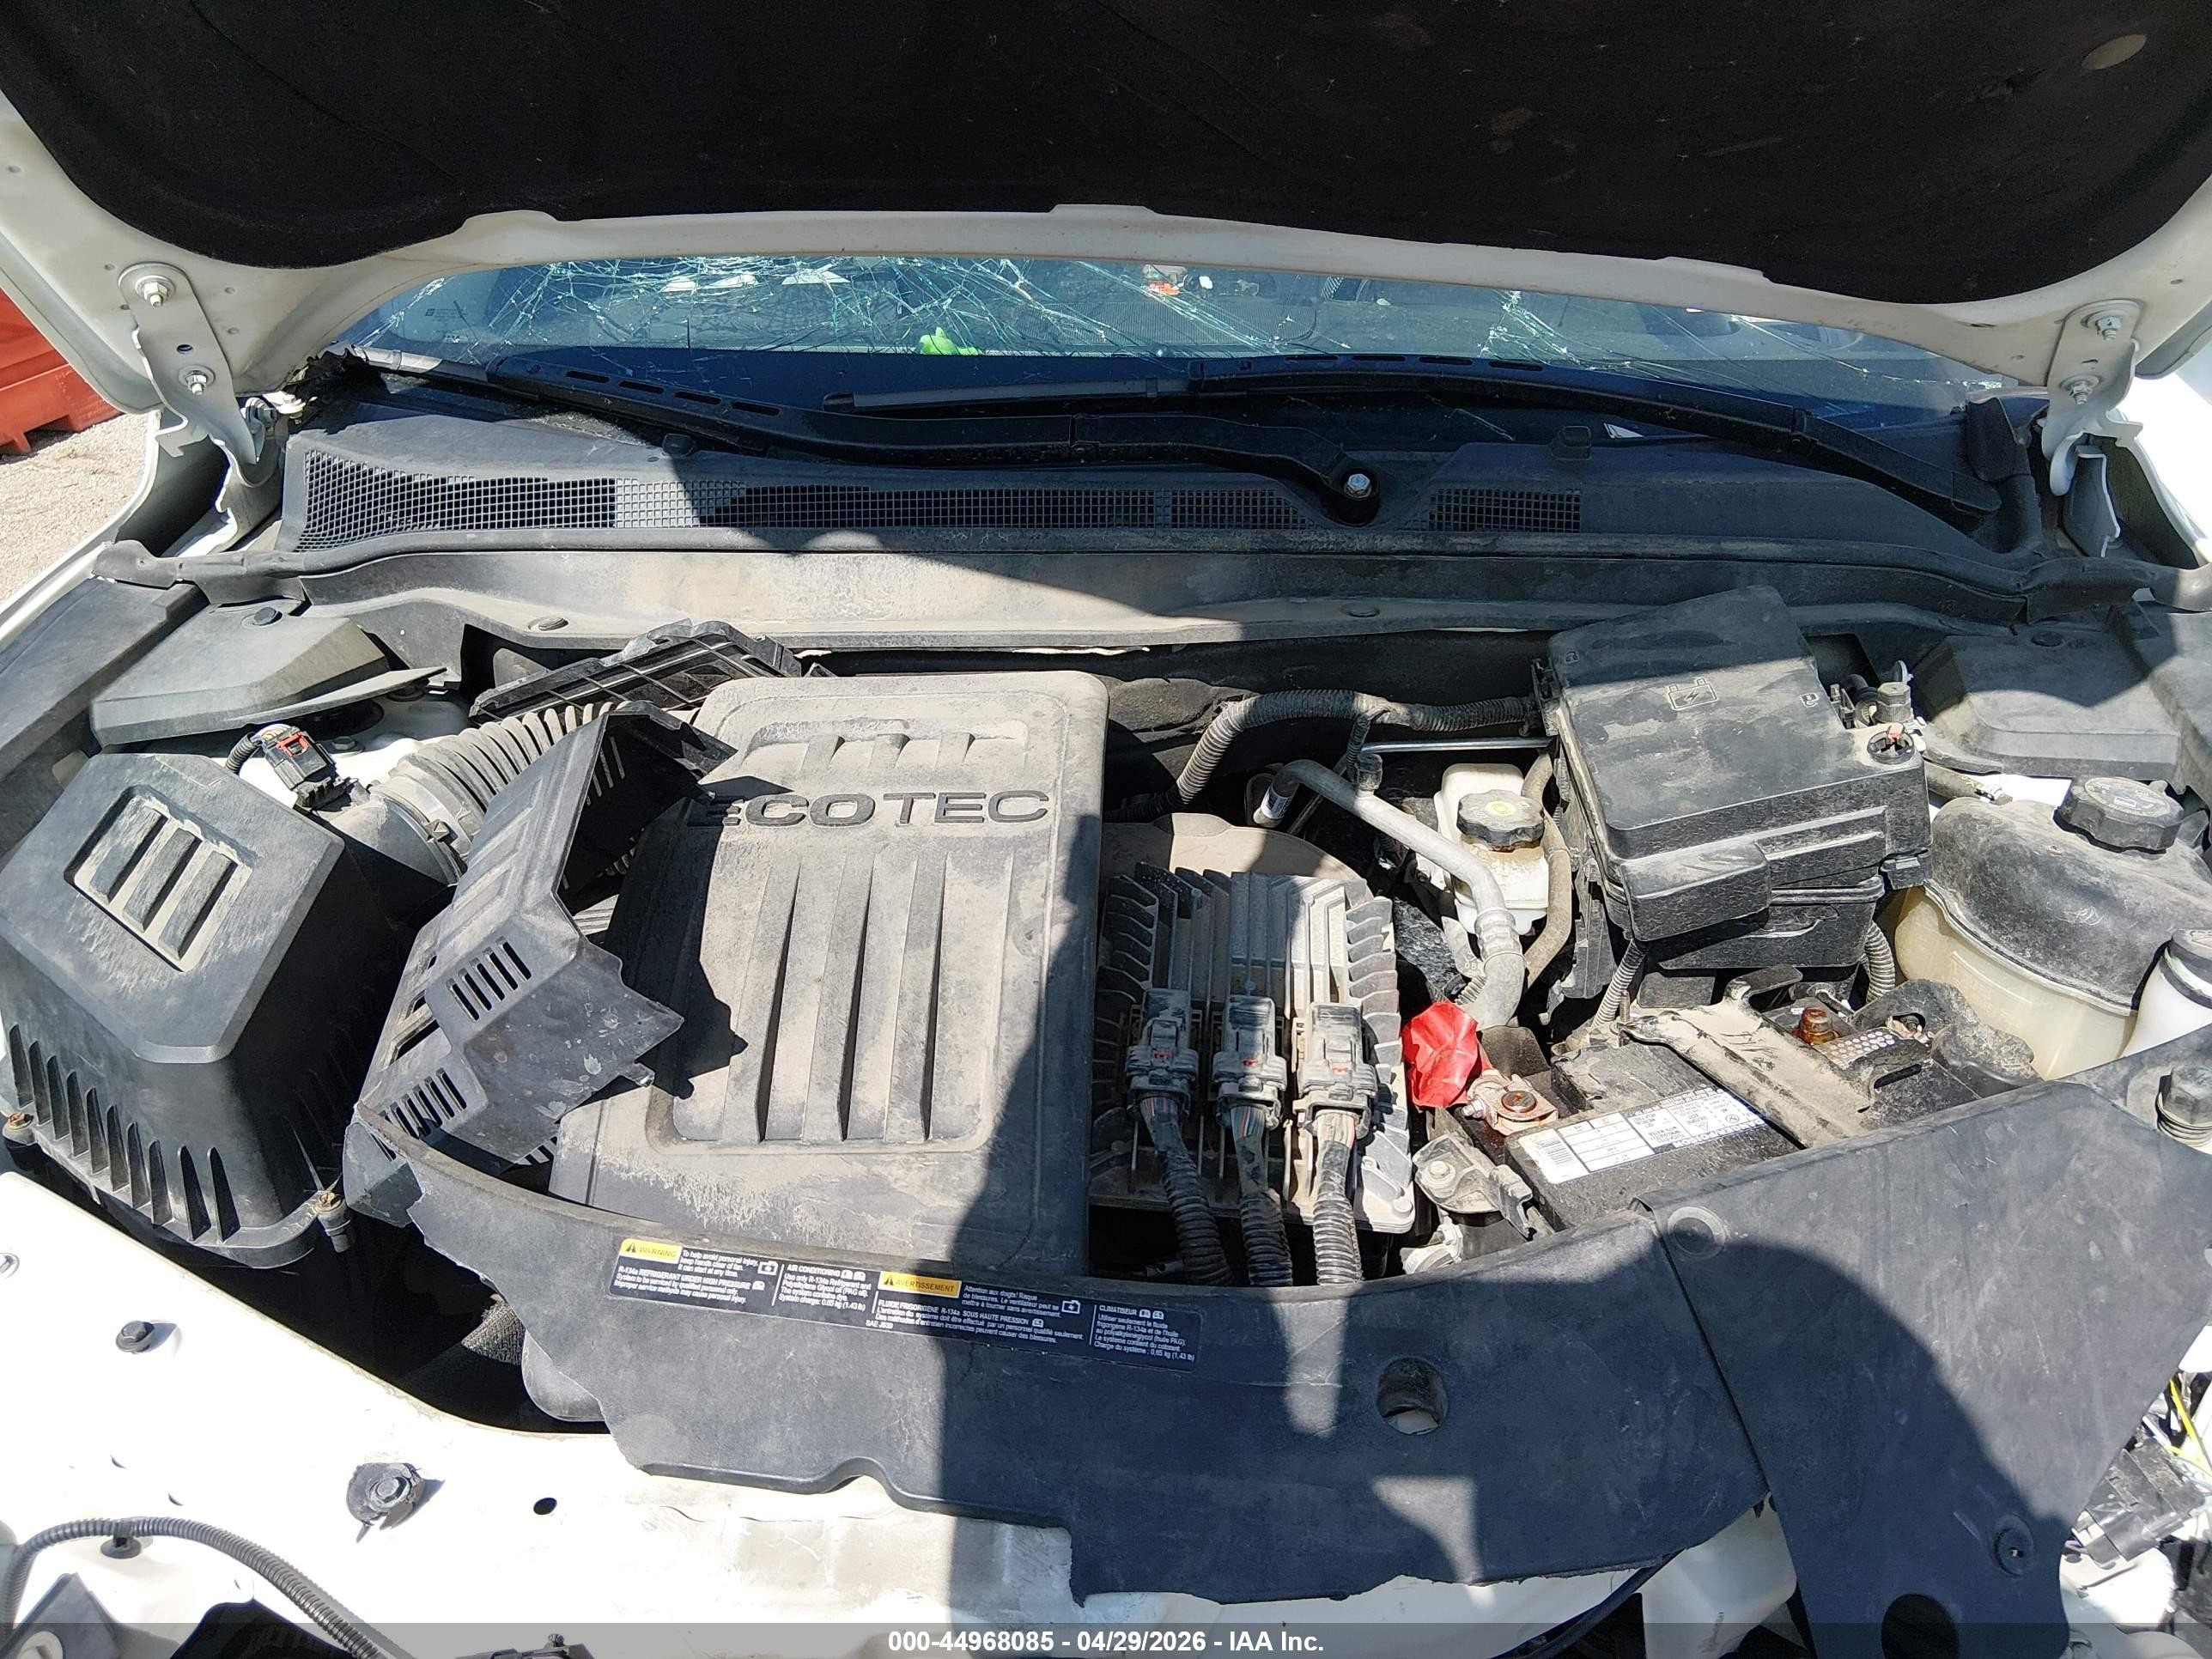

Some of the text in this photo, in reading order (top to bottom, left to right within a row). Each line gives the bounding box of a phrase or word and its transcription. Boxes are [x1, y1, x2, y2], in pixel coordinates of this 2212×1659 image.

[895, 1279, 955, 1292] AVERTISSEMENT
[1099, 1305, 1137, 1316] CLIMATISEUR
[979, 1312, 1000, 1322] HAUTE
[1000, 1315, 1029, 1325] PRESSION
